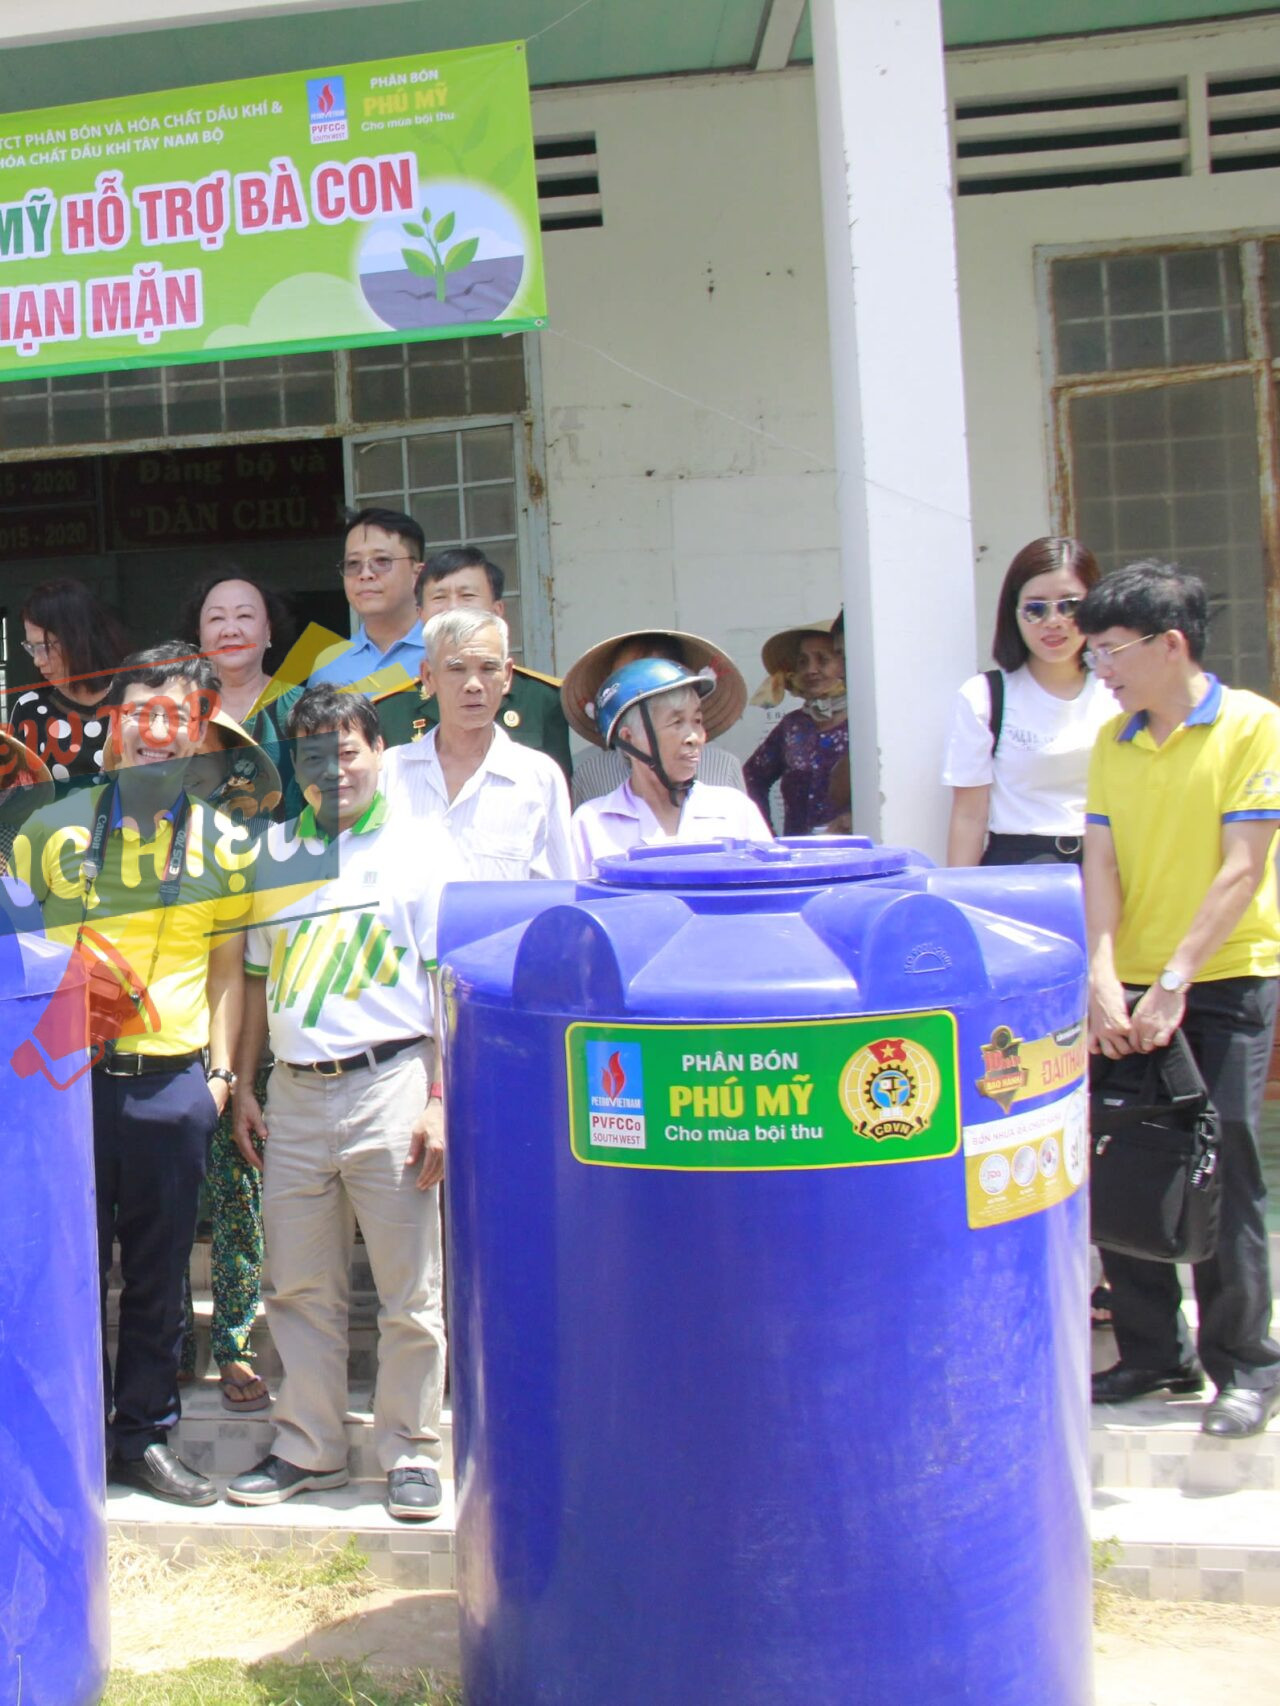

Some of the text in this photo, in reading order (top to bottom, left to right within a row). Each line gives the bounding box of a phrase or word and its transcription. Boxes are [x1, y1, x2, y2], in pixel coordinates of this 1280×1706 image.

[370, 69, 439, 89] PHÂN BÓN
[364, 81, 448, 116] PHÚ MỸ
[25, 129, 66, 147] PHÂN
[70, 122, 102, 141] BÓN
[104, 120, 124, 136] VÀ
[128, 114, 160, 133] HÓA
[163, 108, 203, 129] CHẤT
[241, 100, 268, 118] KHÍ
[271, 101, 283, 115] &
[312, 122, 346, 134] PVFCCo
[361, 120, 385, 132] Cho
[435, 111, 455, 122] thu
[29, 146, 68, 166] CHẤT
[106, 137, 132, 157] KHÍ
[133, 134, 160, 151] TÂY
[163, 131, 199, 148] NAM
[202, 127, 225, 144] BỘ
[66, 176, 125, 249] HỖ
[139, 176, 225, 246] TRỢ
[241, 163, 303, 229] BÀ
[317, 157, 414, 220] CON
[92, 267, 198, 339] MẶN
[139, 447, 328, 486] Đảng bộ và
[91, 814, 108, 850] Canon
[168, 830, 187, 875] EOS 70D
[681, 1050, 799, 1072] PHÂN BÓN
[669, 1074, 815, 1118] PHÚ MỸ
[592, 1115, 641, 1132] PVFCCo
[593, 1132, 641, 1145] SOUTH WEST
[664, 1123, 824, 1144] Cho mùa bội thu
